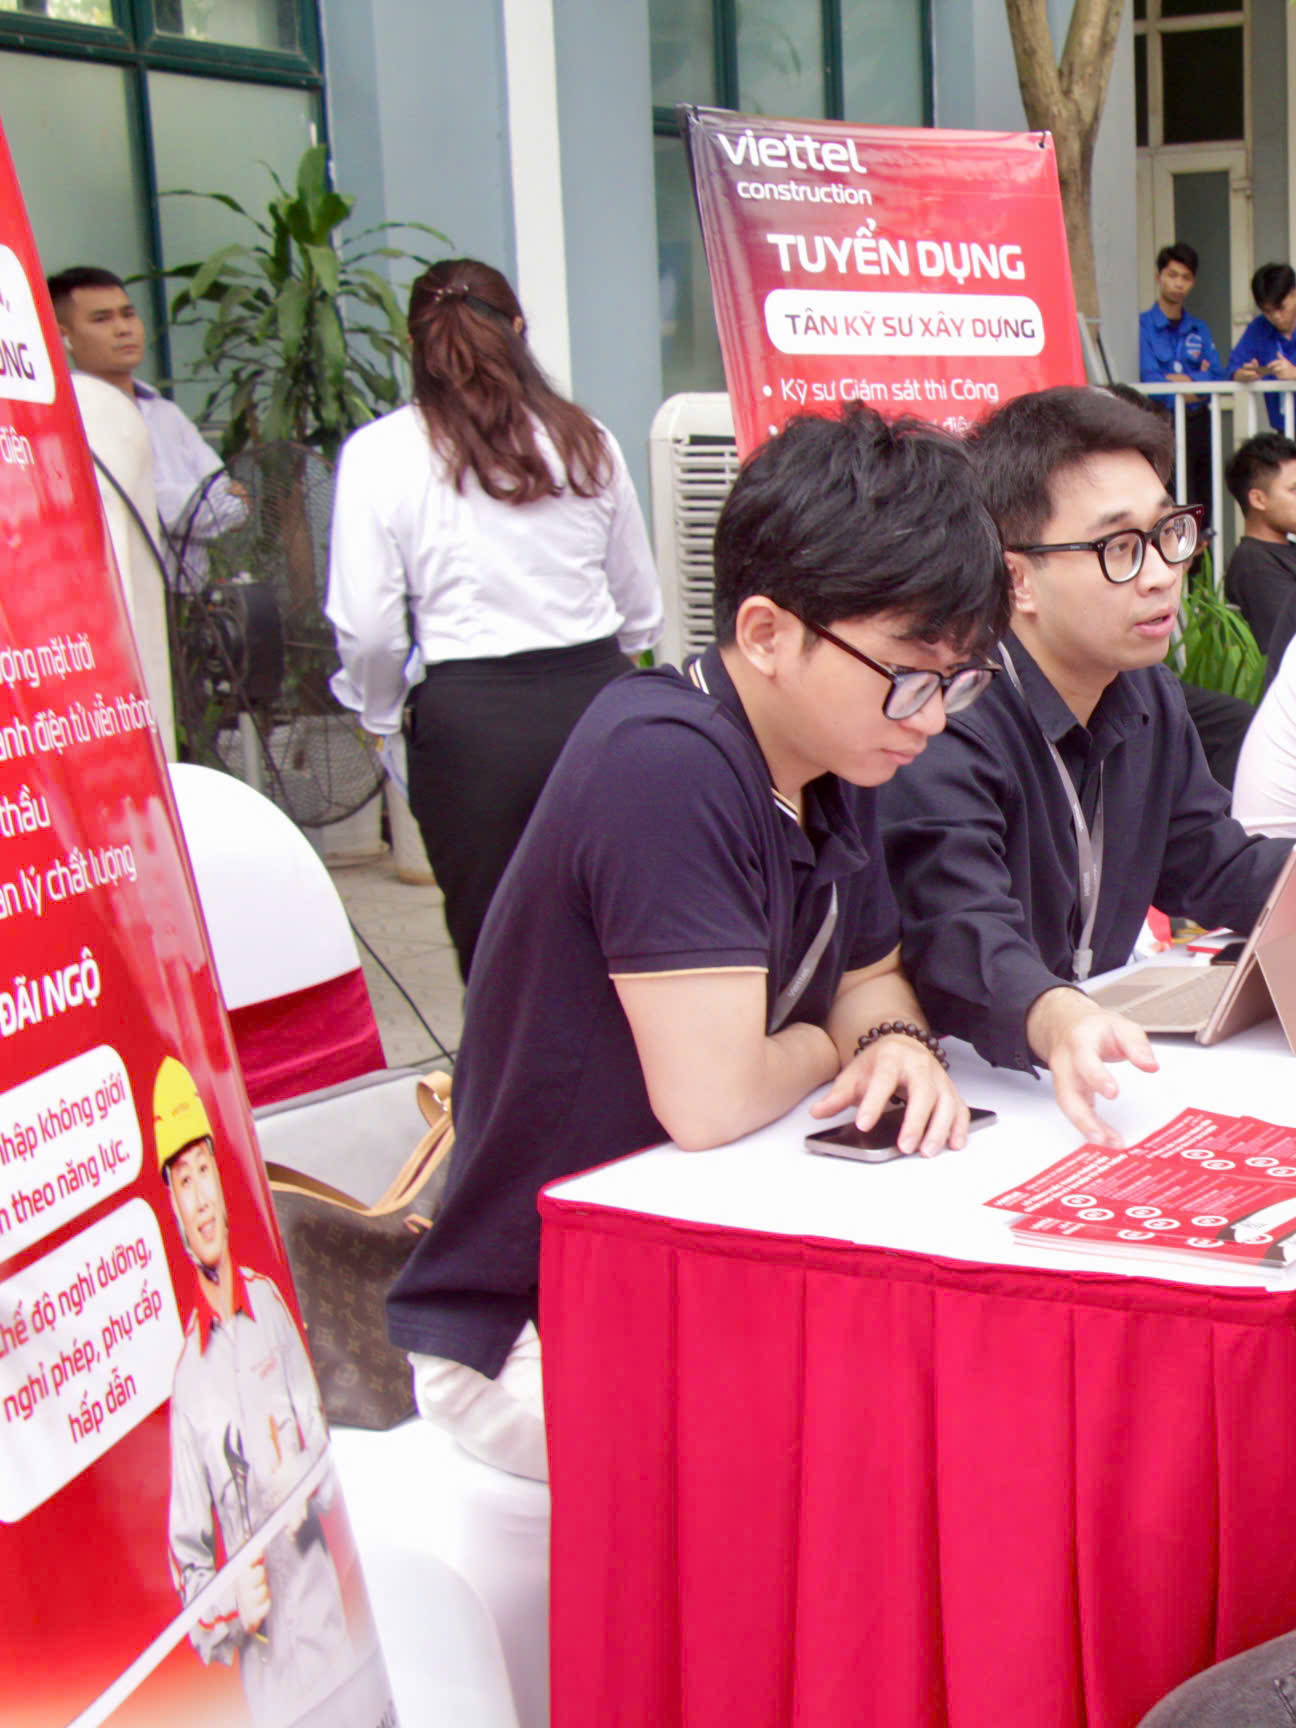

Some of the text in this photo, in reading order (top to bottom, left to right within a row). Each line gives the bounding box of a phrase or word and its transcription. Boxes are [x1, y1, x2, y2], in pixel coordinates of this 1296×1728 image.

[718, 130, 867, 174] viettel
[737, 179, 873, 206] construction
[766, 217, 1026, 284] TUYỂN DỤNG
[785, 308, 1036, 343] TÂN KỸ SƯ XÂY DỰNG
[781, 376, 999, 406] Kỹ sư Giám sát thi Công
[0, 632, 97, 688] ợng mặt trời
[34, 708, 74, 755] điện
[69, 701, 91, 743] tử
[88, 692, 121, 739] viễn
[115, 692, 157, 733] thông
[20, 865, 42, 917] lý
[46, 846, 95, 901] chất
[88, 844, 137, 887] lượng
[43, 946, 101, 1017] NGỘ
[37, 1098, 95, 1143] không
[94, 1072, 126, 1120] giới
[11, 1181, 56, 1224] theo
[57, 1160, 101, 1198] năng
[98, 1139, 131, 1175] lực.
[31, 1291, 57, 1335] độ
[57, 1261, 97, 1317] nghỉ
[96, 1237, 152, 1290] dưỡng,
[2, 1278, 163, 1422] nghỉ phép, phụ cấp
[67, 1365, 137, 1444] hấp dẫn
